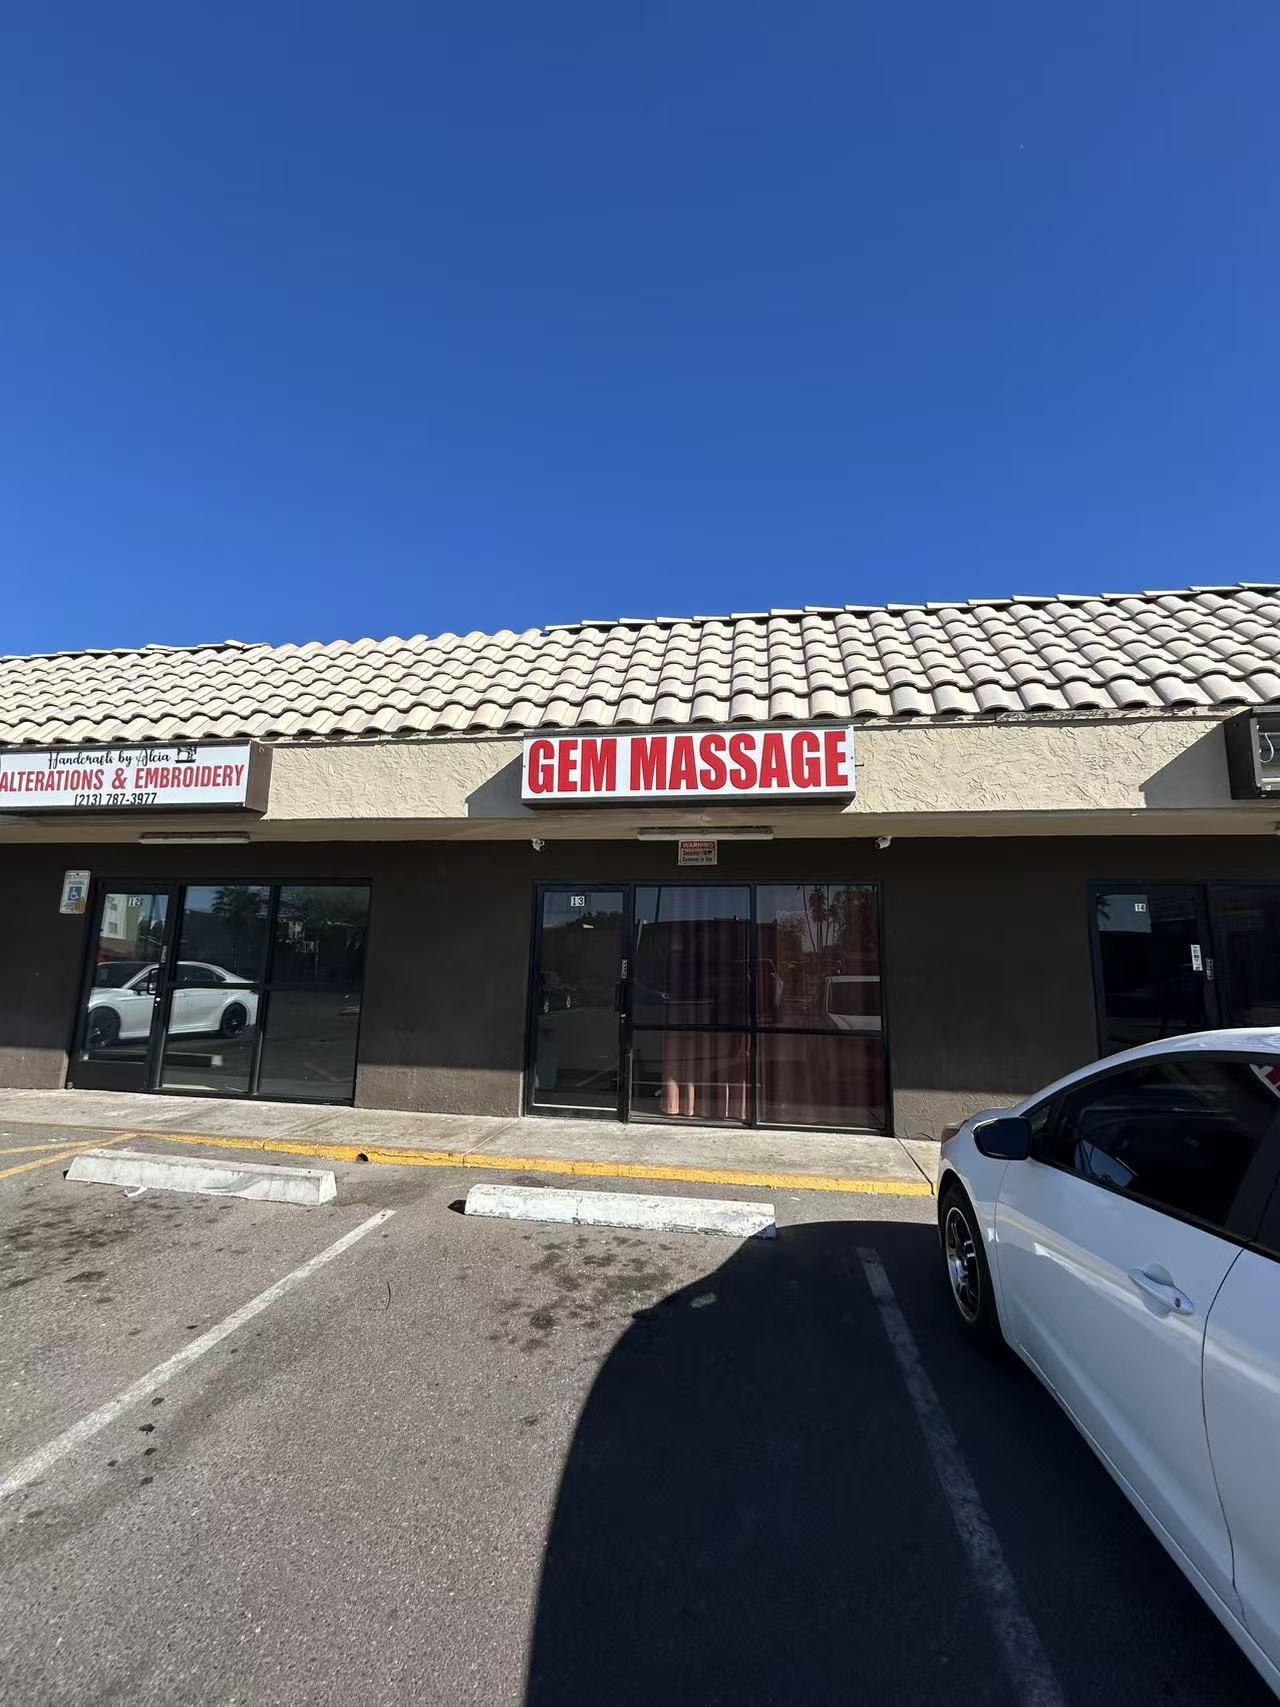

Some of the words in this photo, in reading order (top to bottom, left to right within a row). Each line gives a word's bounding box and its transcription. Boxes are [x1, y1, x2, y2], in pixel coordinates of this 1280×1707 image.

[48, 751, 114, 769] Handcrafts
[118, 750, 133, 767] by
[527, 738, 617, 793] GEM
[629, 730, 849, 791] MASSAGE
[0, 767, 105, 792] ALTERATIONS
[111, 767, 128, 790] &
[134, 764, 245, 789] EMBROIDERY
[74, 793, 102, 806] (213)
[106, 792, 157, 805] 787-3977
[130, 897, 140, 906] 12
[572, 896, 584, 906] 13
